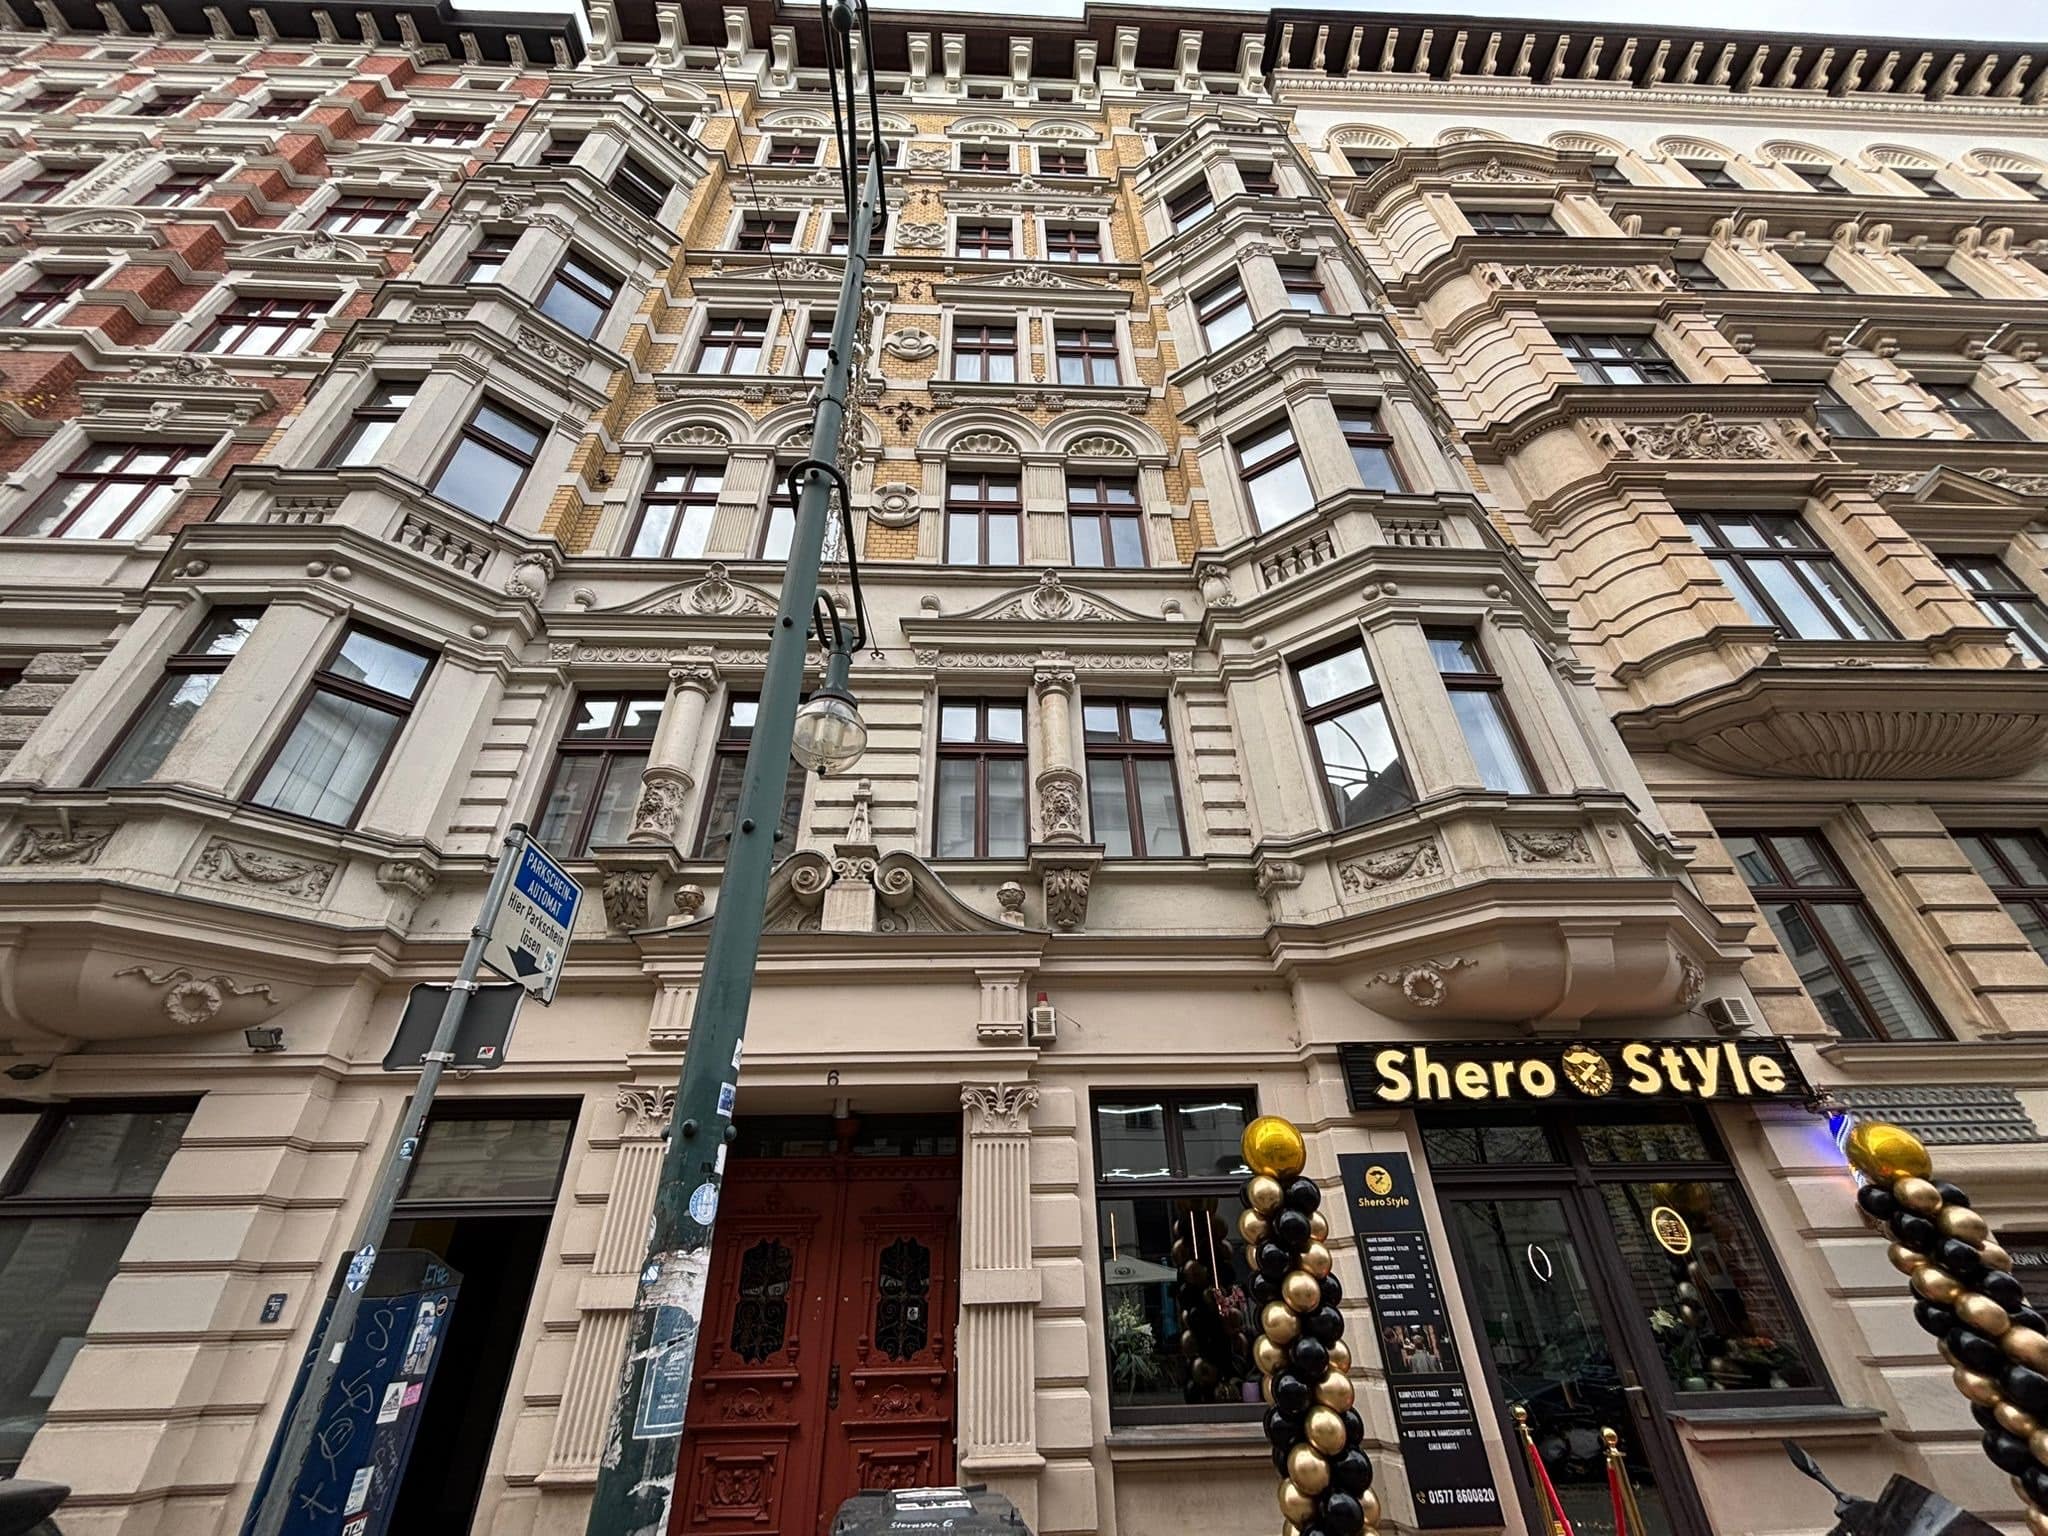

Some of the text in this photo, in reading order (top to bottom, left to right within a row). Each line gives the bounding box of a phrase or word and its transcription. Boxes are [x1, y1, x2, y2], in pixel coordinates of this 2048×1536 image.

[526, 852, 573, 901] PARKSCHEIN-
[527, 880, 563, 917] AUTOMAT
[507, 892, 564, 948] Hier Parkschein
[520, 928, 542, 955] lösen
[828, 1070, 840, 1087] 6
[1375, 1042, 1787, 1100] Shero Style
[1358, 1196, 1410, 1208] Shero Style
[1428, 1487, 1496, 1504] 01577 8600820
